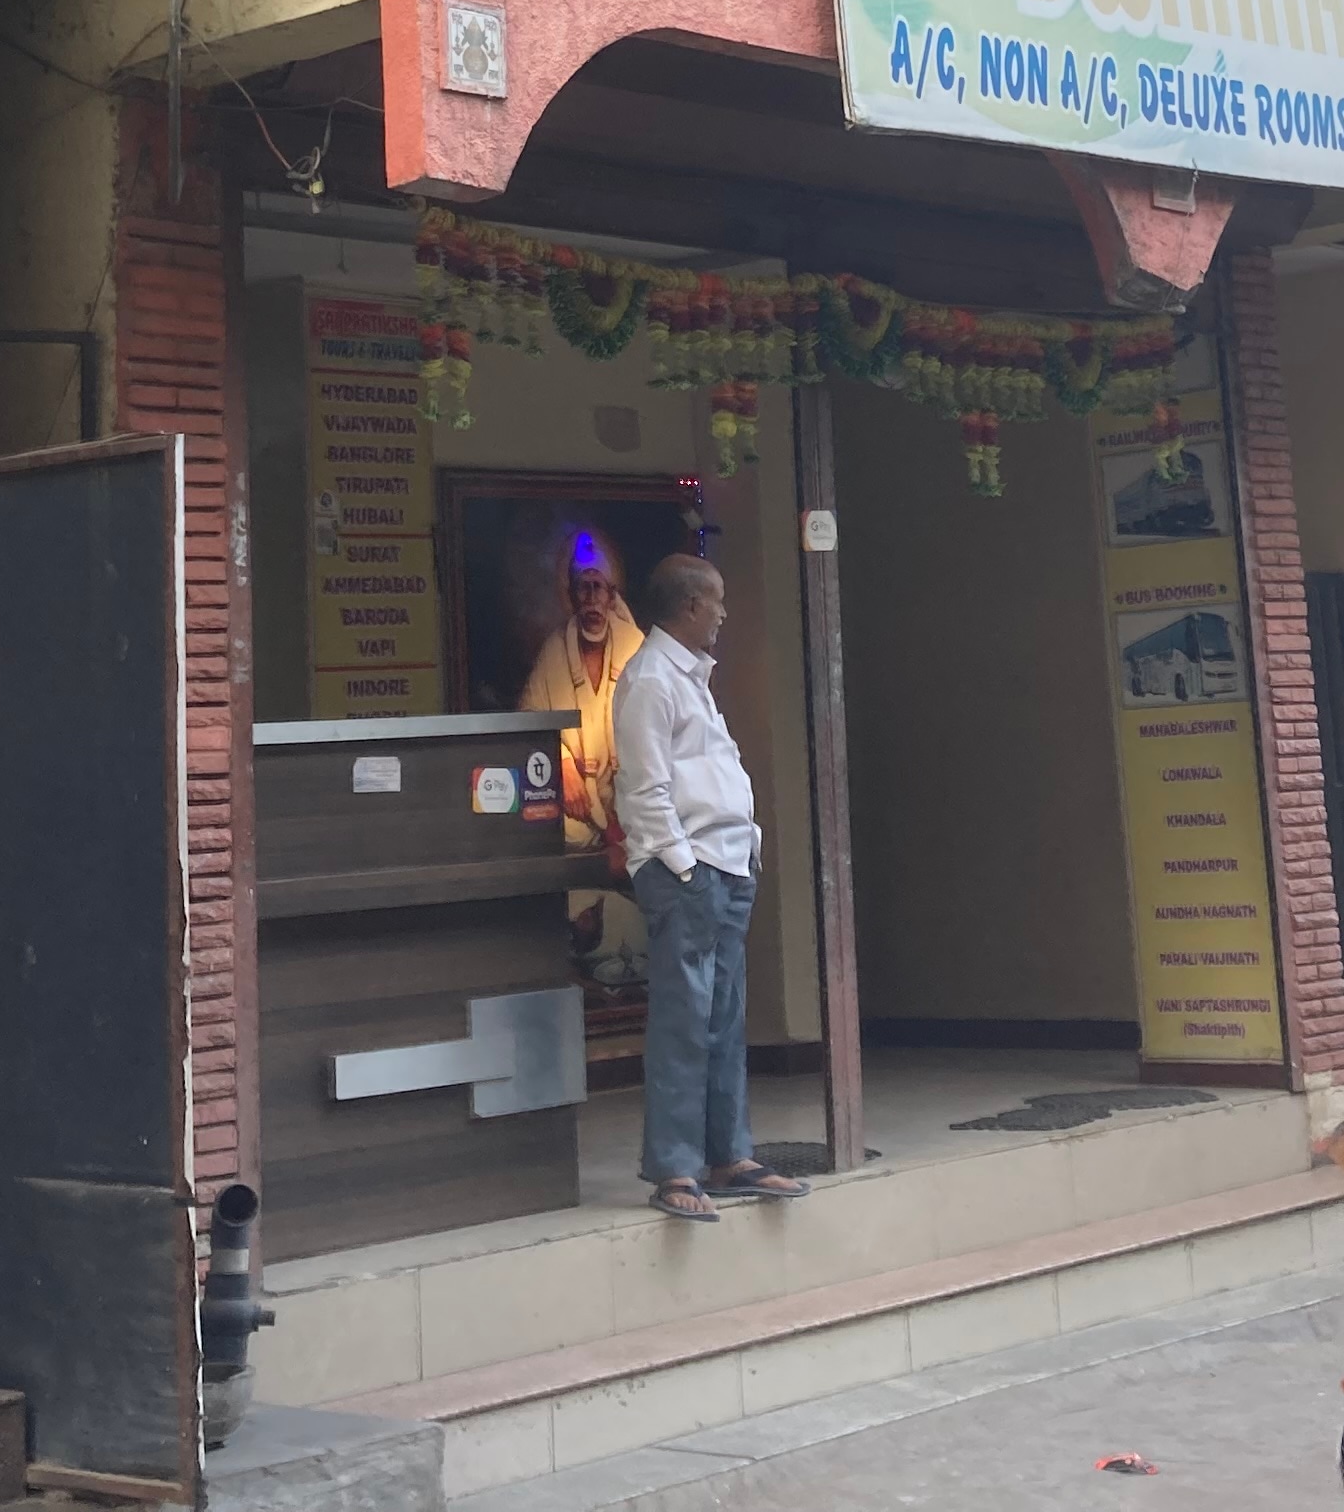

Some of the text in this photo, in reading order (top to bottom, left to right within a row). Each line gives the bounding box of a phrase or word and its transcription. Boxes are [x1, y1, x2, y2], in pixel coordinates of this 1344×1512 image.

[891, 17, 964, 106] A/C,
[979, 37, 1049, 106] NON
[1060, 55, 1127, 132] A/C,
[1138, 61, 1247, 136] DELUXE
[320, 382, 418, 405] HYDERABAD
[323, 413, 417, 435] VIJAYWADA
[342, 506, 404, 526] HUBALI
[347, 545, 401, 564] SURAT
[1125, 583, 1217, 606] BUS BOOKING
[340, 607, 410, 626] BARODA
[357, 638, 396, 657] VAPI
[346, 678, 410, 697] INDORE
[1166, 813, 1227, 828] KHANDALA
